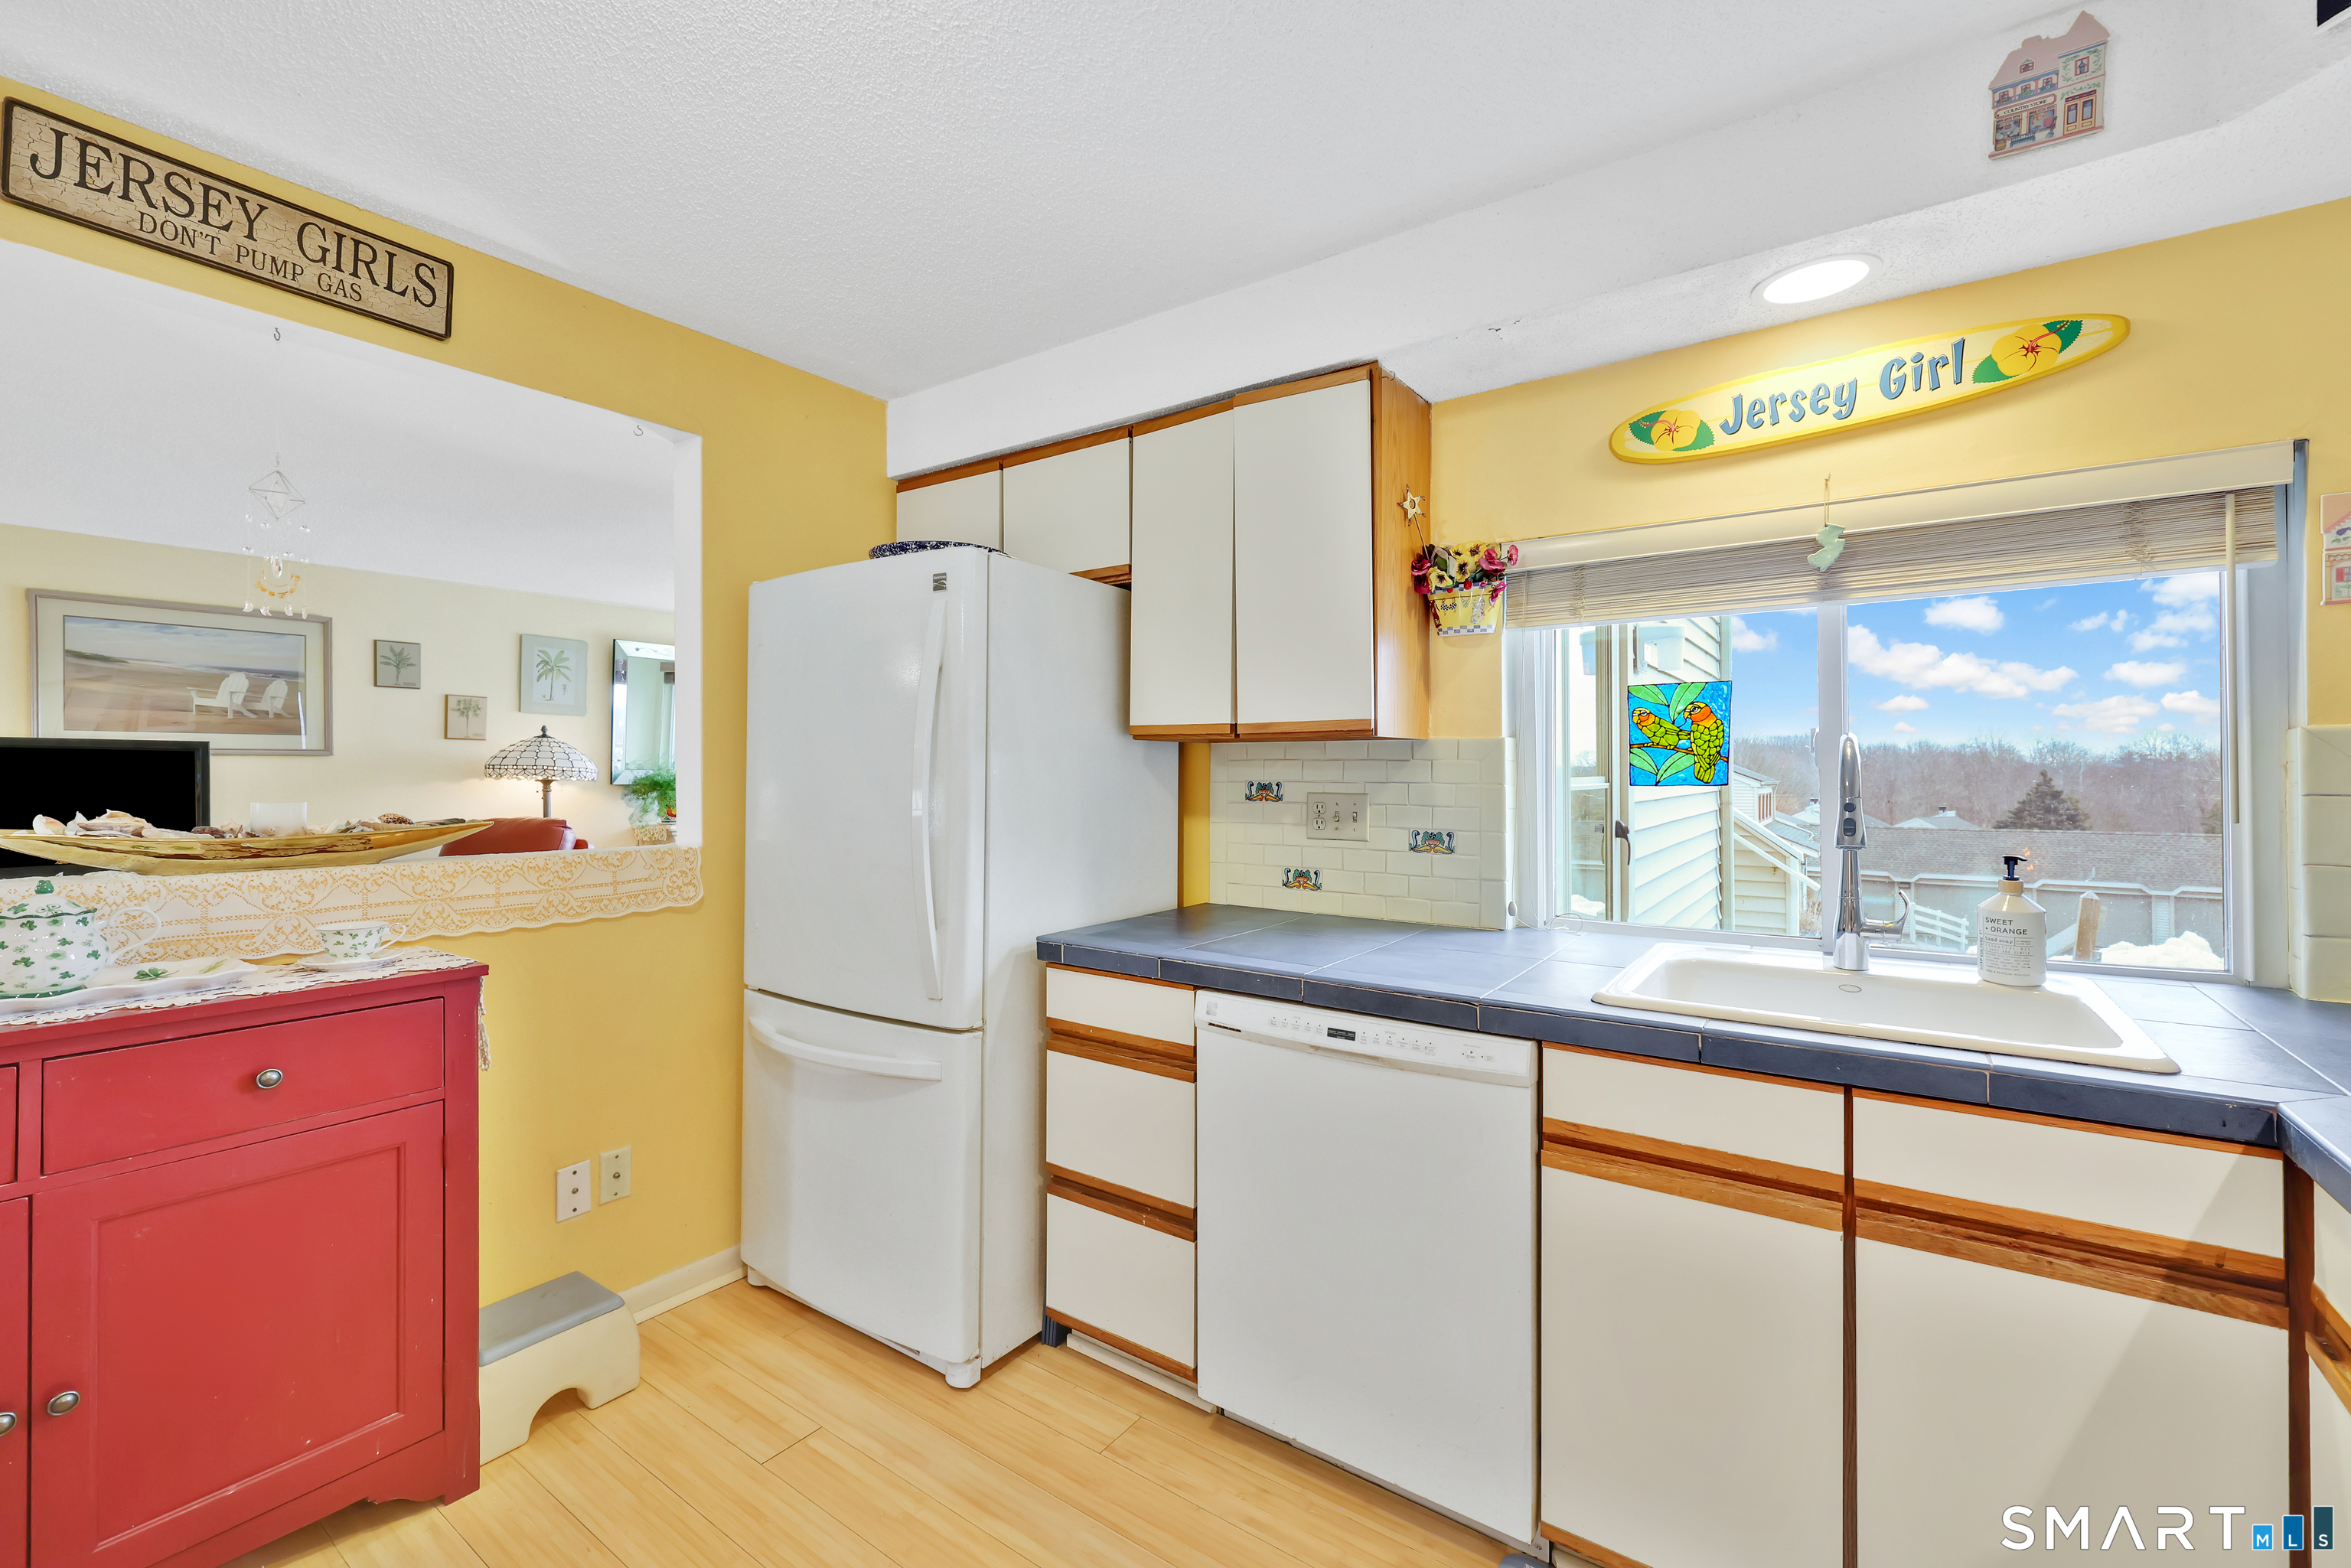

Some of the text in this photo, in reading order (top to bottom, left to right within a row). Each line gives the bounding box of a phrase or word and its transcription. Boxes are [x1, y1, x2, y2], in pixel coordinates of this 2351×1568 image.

[2004, 104, 2030, 114] COUNTRY
[30, 127, 438, 308] JERSEY GIRLS
[138, 211, 362, 302] DON'T PUMP GAS
[1719, 337, 1966, 435] Jersey Girl
[1985, 917, 2014, 926] SWEET
[1991, 926, 2028, 935] ORANGE
